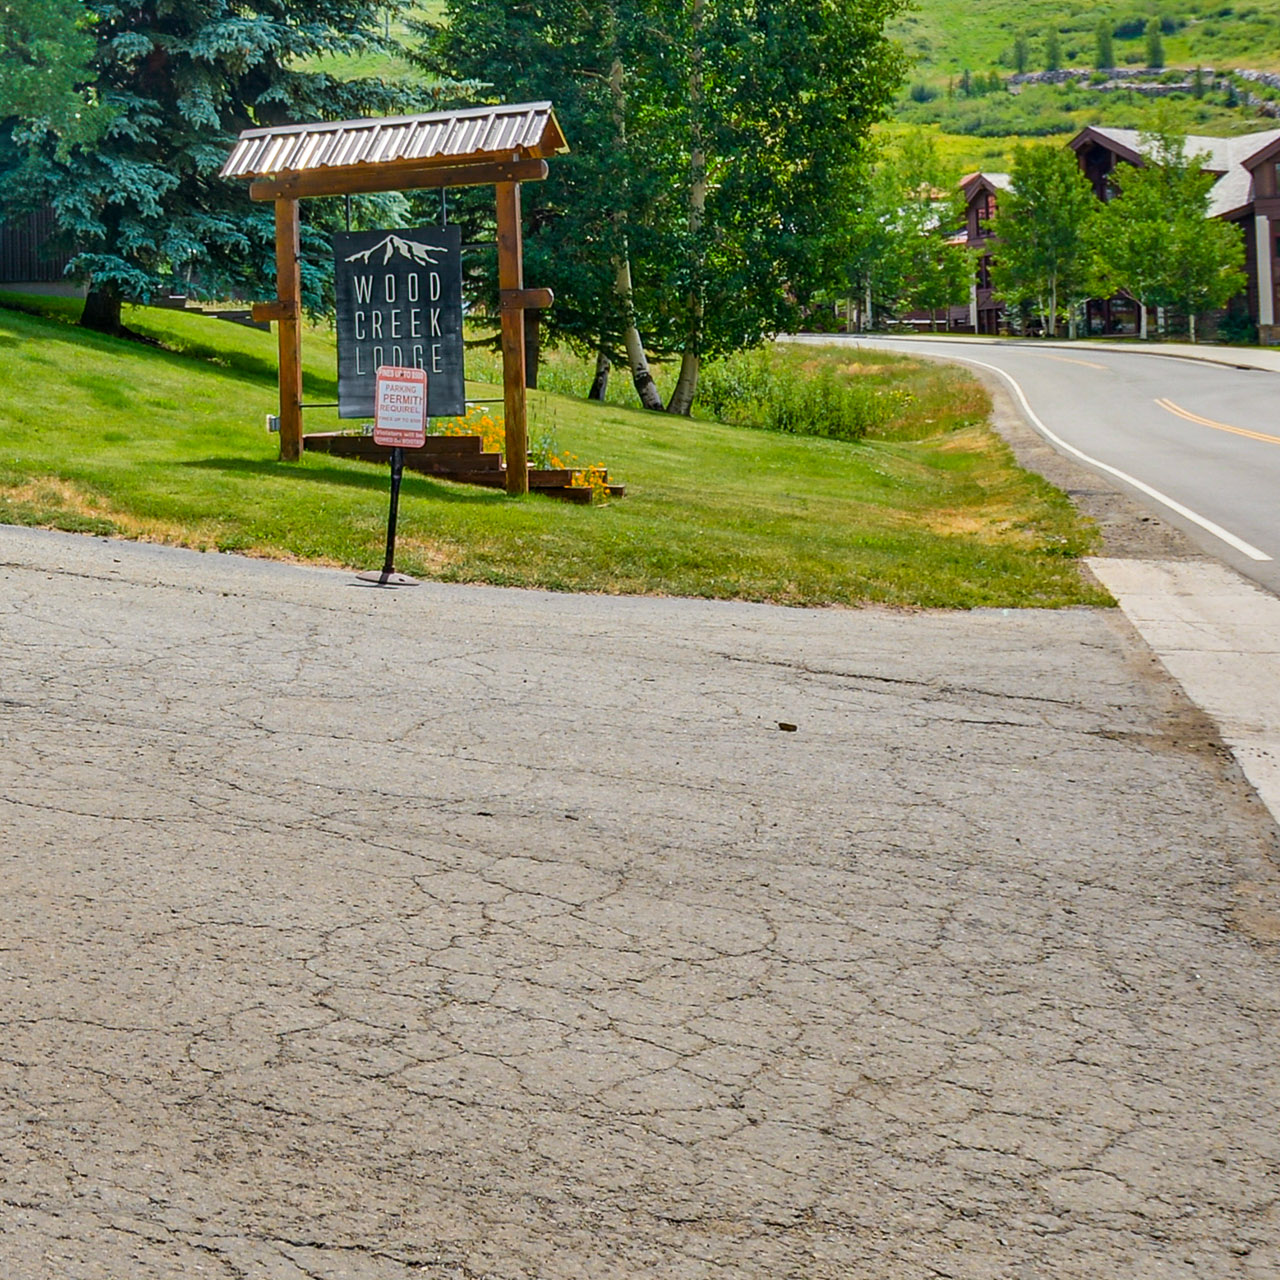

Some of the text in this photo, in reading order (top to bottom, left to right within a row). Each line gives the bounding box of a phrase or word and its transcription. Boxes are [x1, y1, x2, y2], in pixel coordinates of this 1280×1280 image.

[354, 272, 441, 304] WOOD
[355, 308, 442, 340] CREEK
[356, 344, 442, 375] LODGE
[385, 384, 417, 394] PARKING
